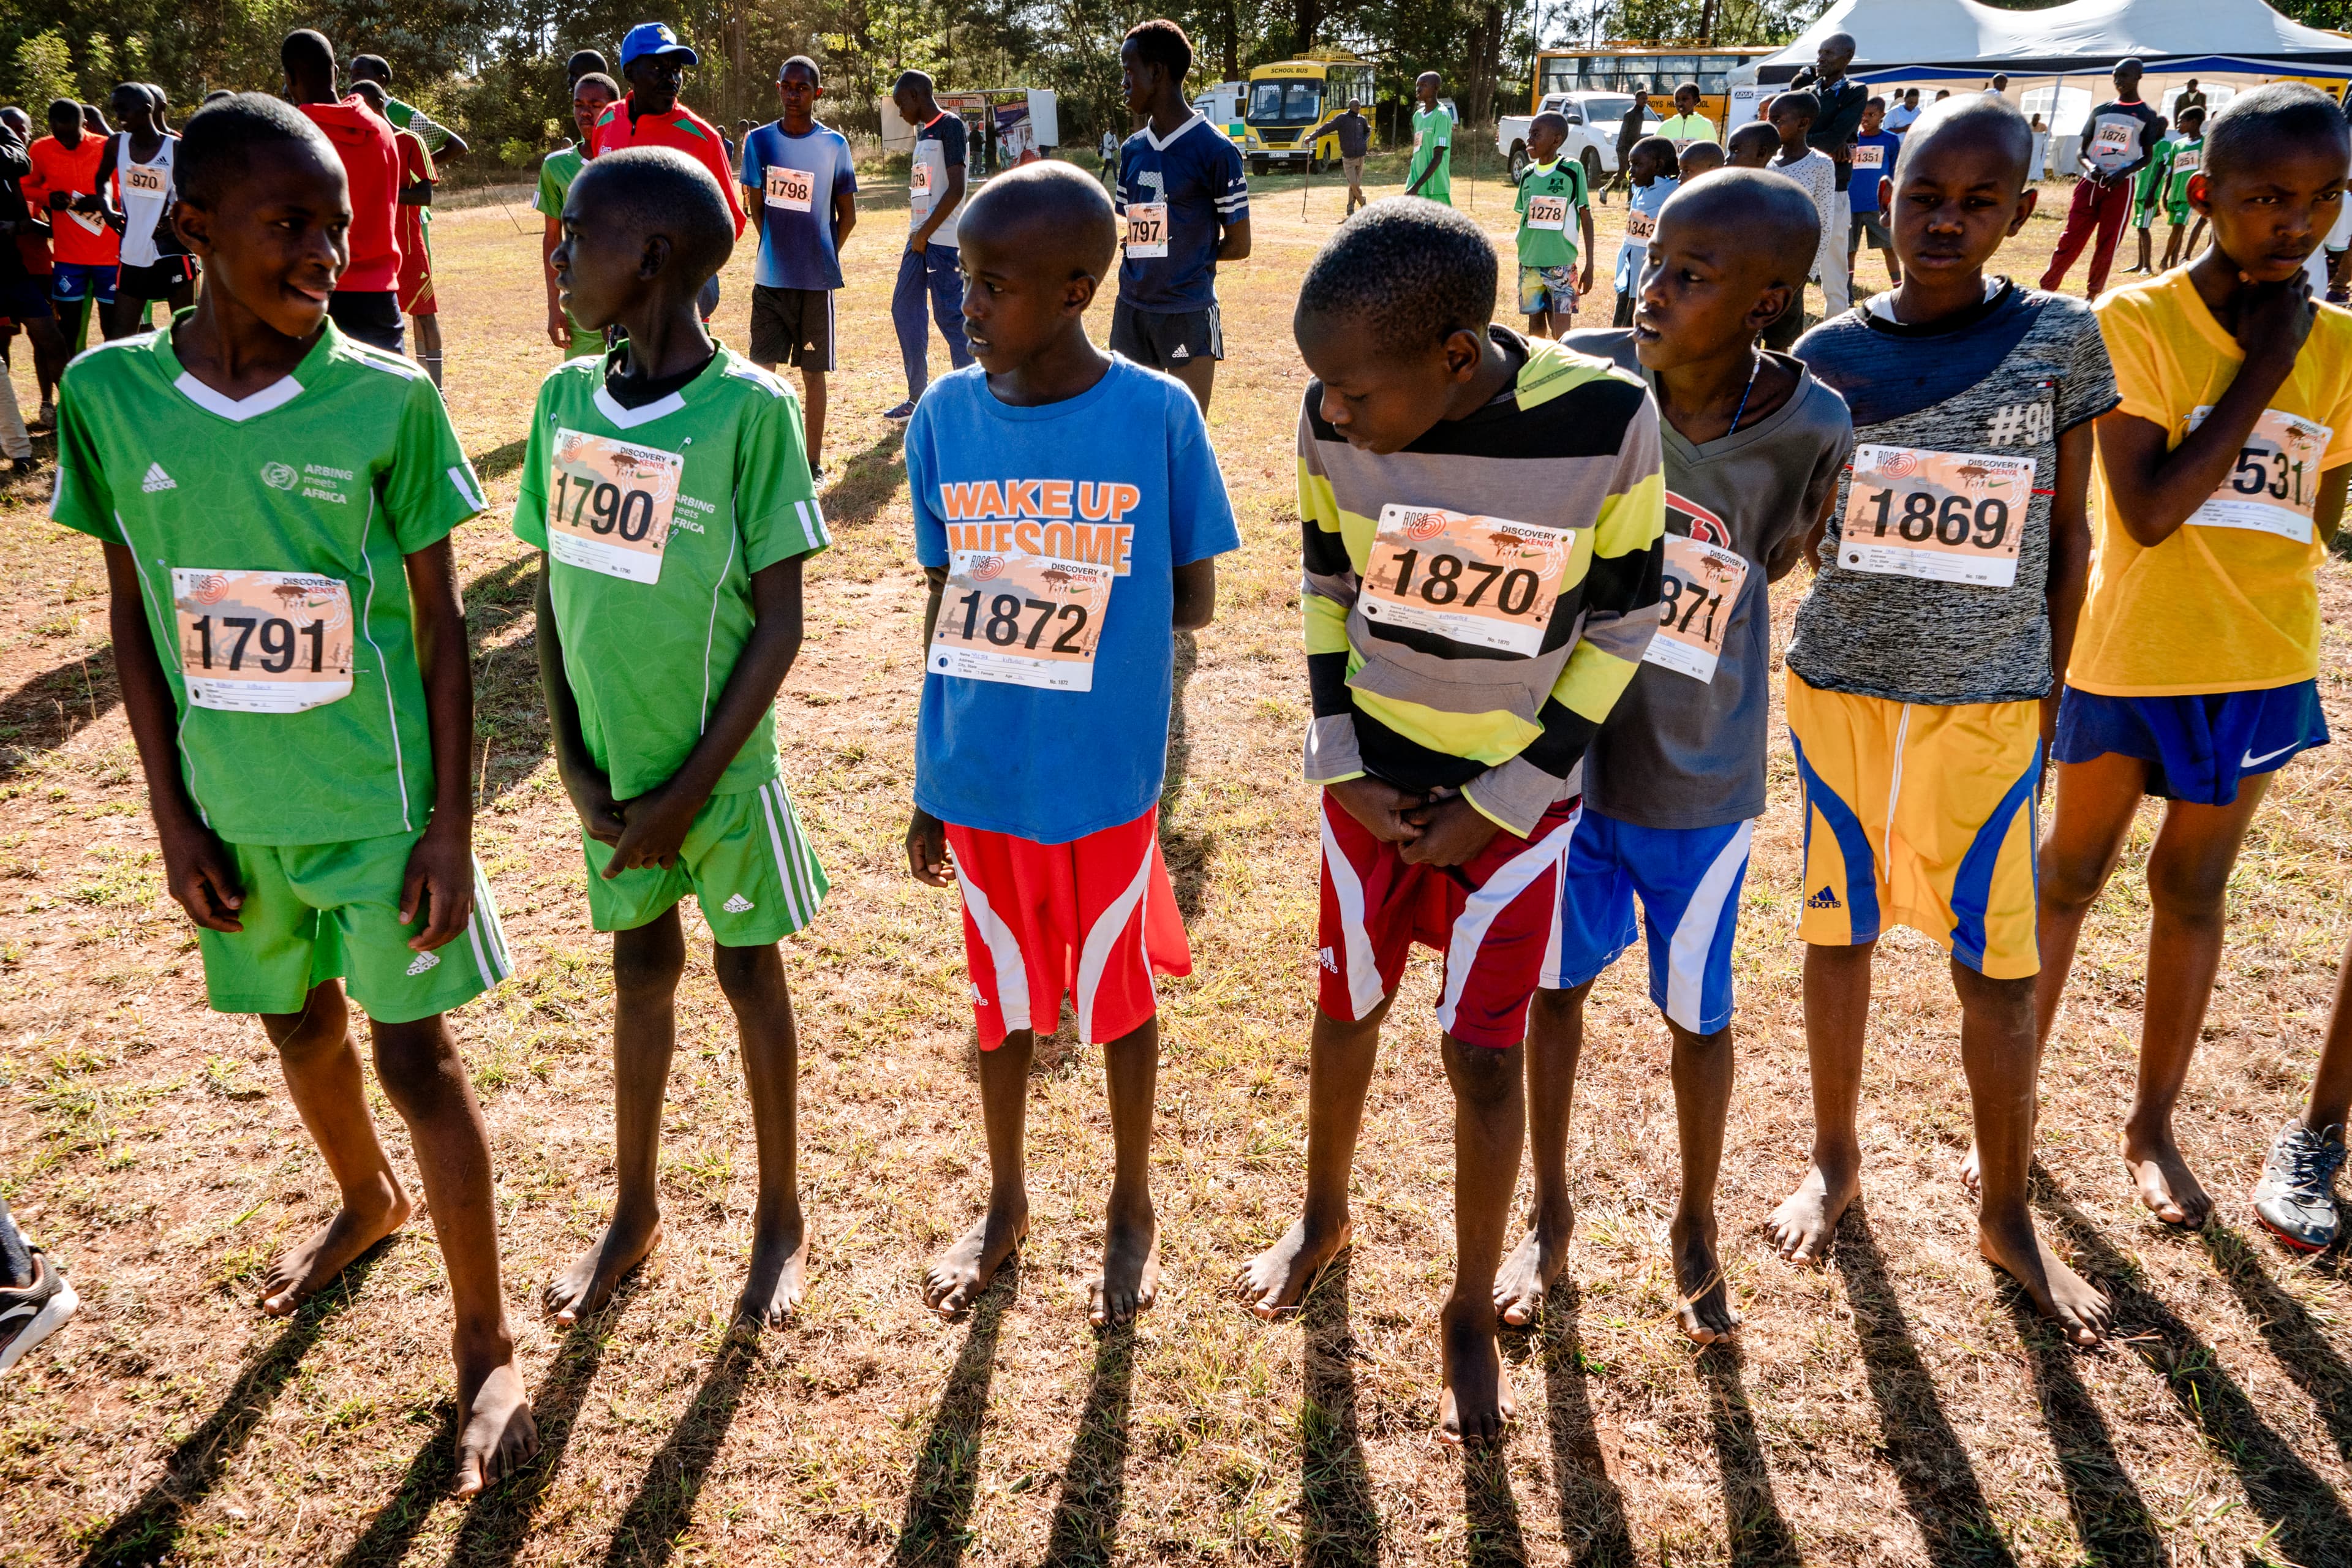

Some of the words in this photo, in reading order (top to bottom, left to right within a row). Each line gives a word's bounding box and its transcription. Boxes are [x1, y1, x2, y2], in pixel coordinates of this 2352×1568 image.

[2102, 130, 2127, 143] 1878
[1857, 153, 1879, 162] 1351
[2176, 157, 2194, 167] 1251
[132, 174, 157, 189] 970
[771, 179, 807, 200] 1798
[1531, 206, 1561, 221] 1278
[1128, 221, 1161, 243] 1797
[1628, 220, 1656, 238] 1343
[172, 274, 183, 284] NB
[620, 446, 667, 463] DISCOVERY
[638, 458, 665, 470] KENYA
[1967, 458, 2019, 469] DISCOVERY
[304, 463, 353, 481] ARBING
[1990, 467, 2018, 477] KENYA
[141, 478, 177, 493] adidas
[303, 475, 337, 489] meets
[302, 487, 347, 505] AFRICA
[674, 492, 716, 514] ARBING
[940, 478, 1074, 521] WAKE
[1077, 481, 1140, 522] UP
[556, 472, 654, 542] 1790
[1403, 511, 1428, 527] ROSA
[1869, 488, 2009, 550] 1869
[1501, 525, 1557, 540] DISCOVERY
[1523, 538, 1554, 548] KENYA
[970, 555, 991, 568] ROSA
[1709, 549, 1742, 567] DISCOVERY
[1051, 562, 1099, 576] DISCOVERY
[1724, 564, 1739, 575] KENYA
[1071, 573, 1098, 583] KENYA
[1392, 548, 1540, 616] 1870
[308, 586, 337, 595] KENYA
[1659, 574, 1723, 643] 871
[960, 590, 1088, 655] 1872
[192, 614, 324, 673] 1791
[723, 902, 755, 913] adidas
[1807, 899, 1841, 909] sports
[406, 956, 440, 976] adidas
